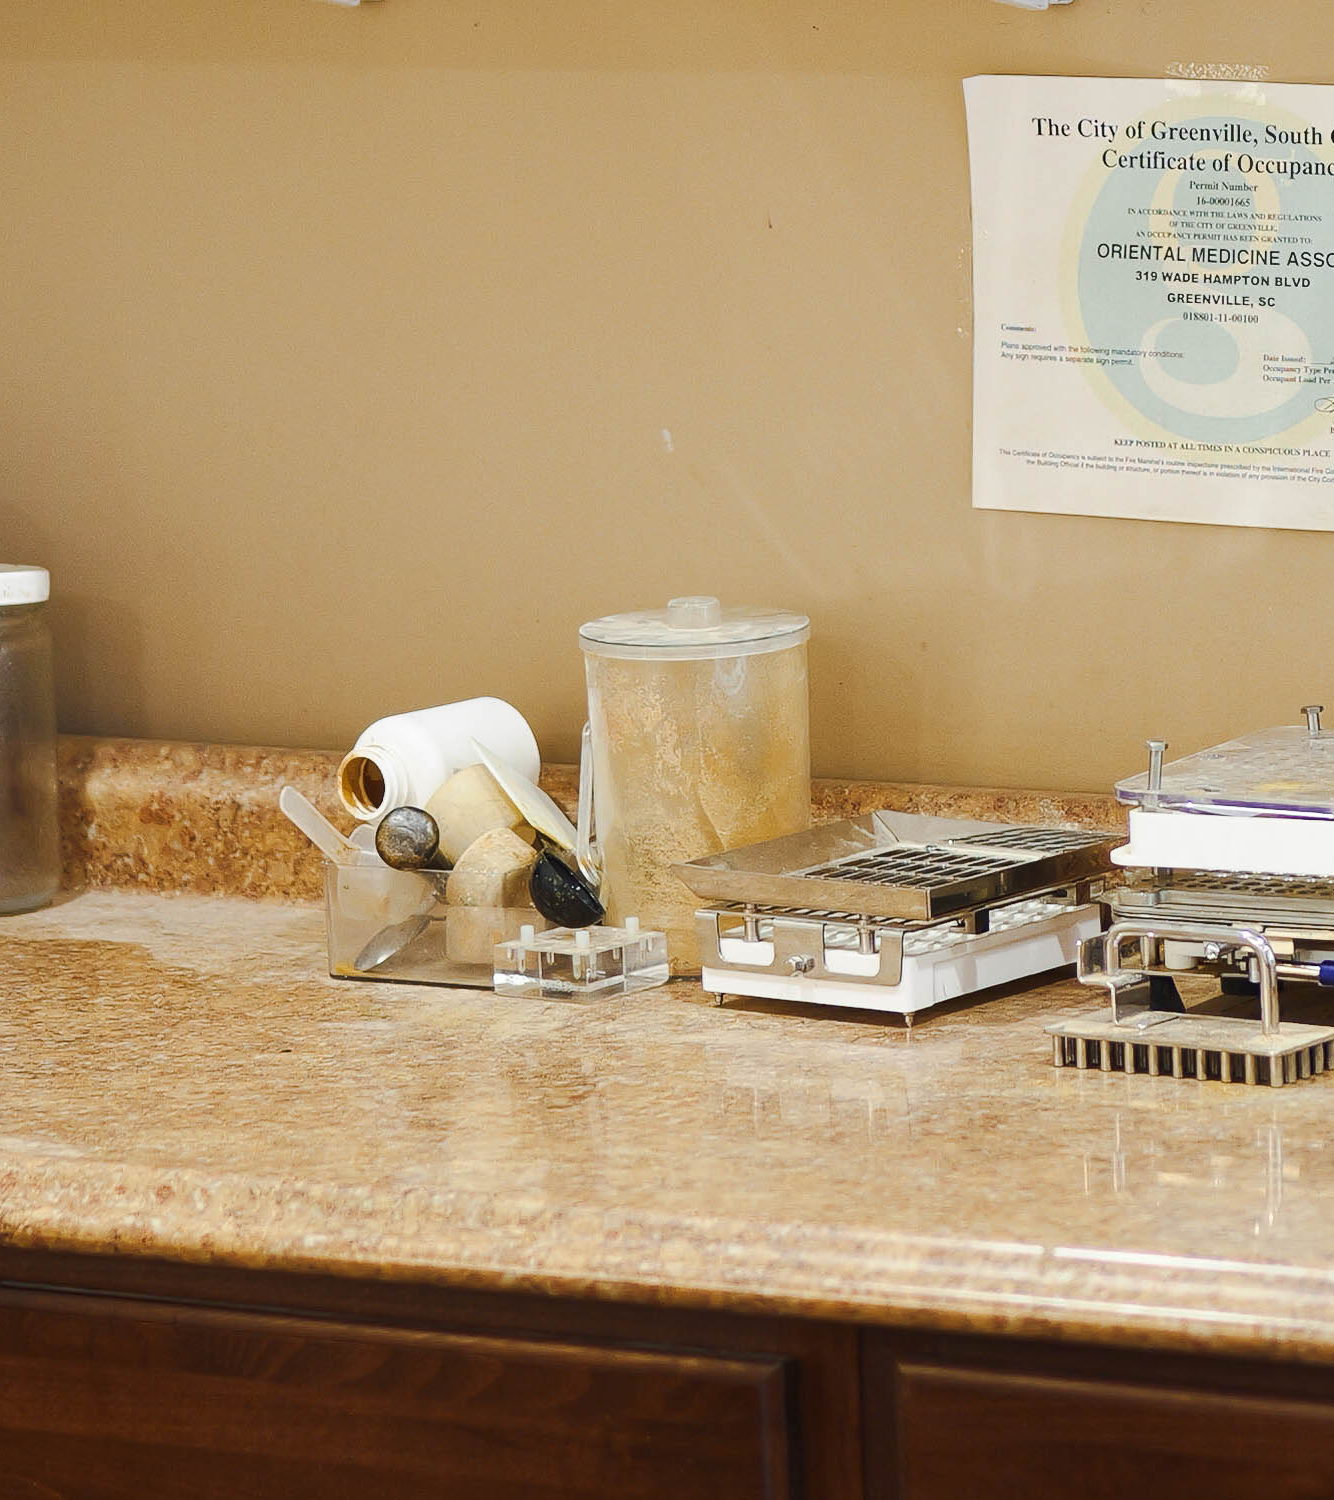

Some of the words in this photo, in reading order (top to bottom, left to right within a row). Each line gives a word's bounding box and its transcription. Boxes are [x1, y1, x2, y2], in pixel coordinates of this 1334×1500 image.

[1032, 117, 1073, 138] The
[1077, 119, 1119, 142] City
[1124, 120, 1145, 140] of
[1150, 121, 1259, 146] Greenville,
[1264, 125, 1324, 146] South
[1102, 149, 1206, 173] Certificate
[1212, 153, 1232, 173] of
[1189, 181, 1218, 191] Permit
[1221, 182, 1259, 193] Number
[1097, 243, 1186, 263] ORIENTAL
[1191, 247, 1281, 266] MEDICINE
[1135, 271, 1157, 283] 319
[1161, 272, 1199, 284] WADE
[1203, 273, 1270, 287] HAMPTON
[1274, 275, 1311, 288] BLVD
[1167, 292, 1253, 306] GREENVILLE,
[1258, 295, 1276, 308] SC
